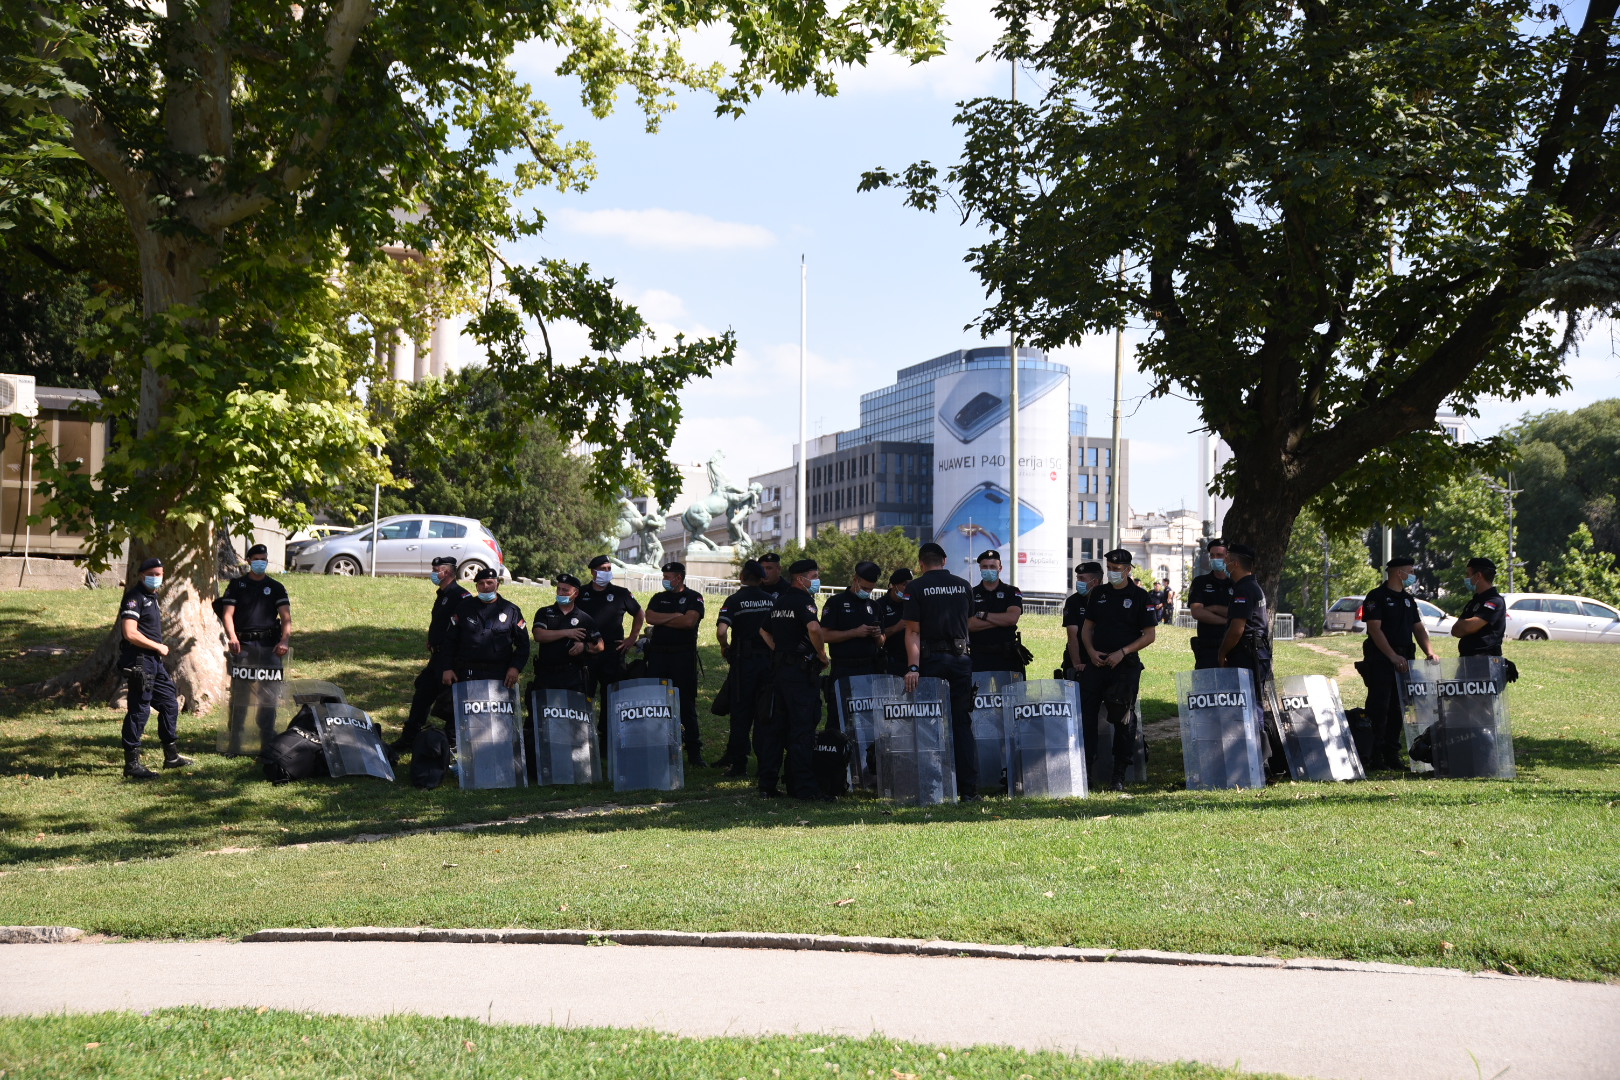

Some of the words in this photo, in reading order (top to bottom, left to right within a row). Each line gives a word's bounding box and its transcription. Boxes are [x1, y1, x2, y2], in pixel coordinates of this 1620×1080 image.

[938, 455, 976, 472] HUAWEI
[981, 454, 1006, 468] P40
[1018, 455, 1043, 471] erija
[1049, 457, 1062, 470] 5G
[923, 585, 967, 596] ПОЛИЦИЈА
[232, 667, 282, 681] POLICIJA
[1437, 681, 1497, 697] POLICIJA
[464, 701, 514, 715] POLICIJA
[1188, 693, 1247, 709] POLICIJA
[543, 707, 590, 723] POLICIJA
[620, 706, 671, 721] POLICIJA
[885, 704, 942, 719] ПОЛИЦИЈА
[1014, 703, 1071, 720] POLICIJA
[325, 717, 374, 732] POLICIJA
